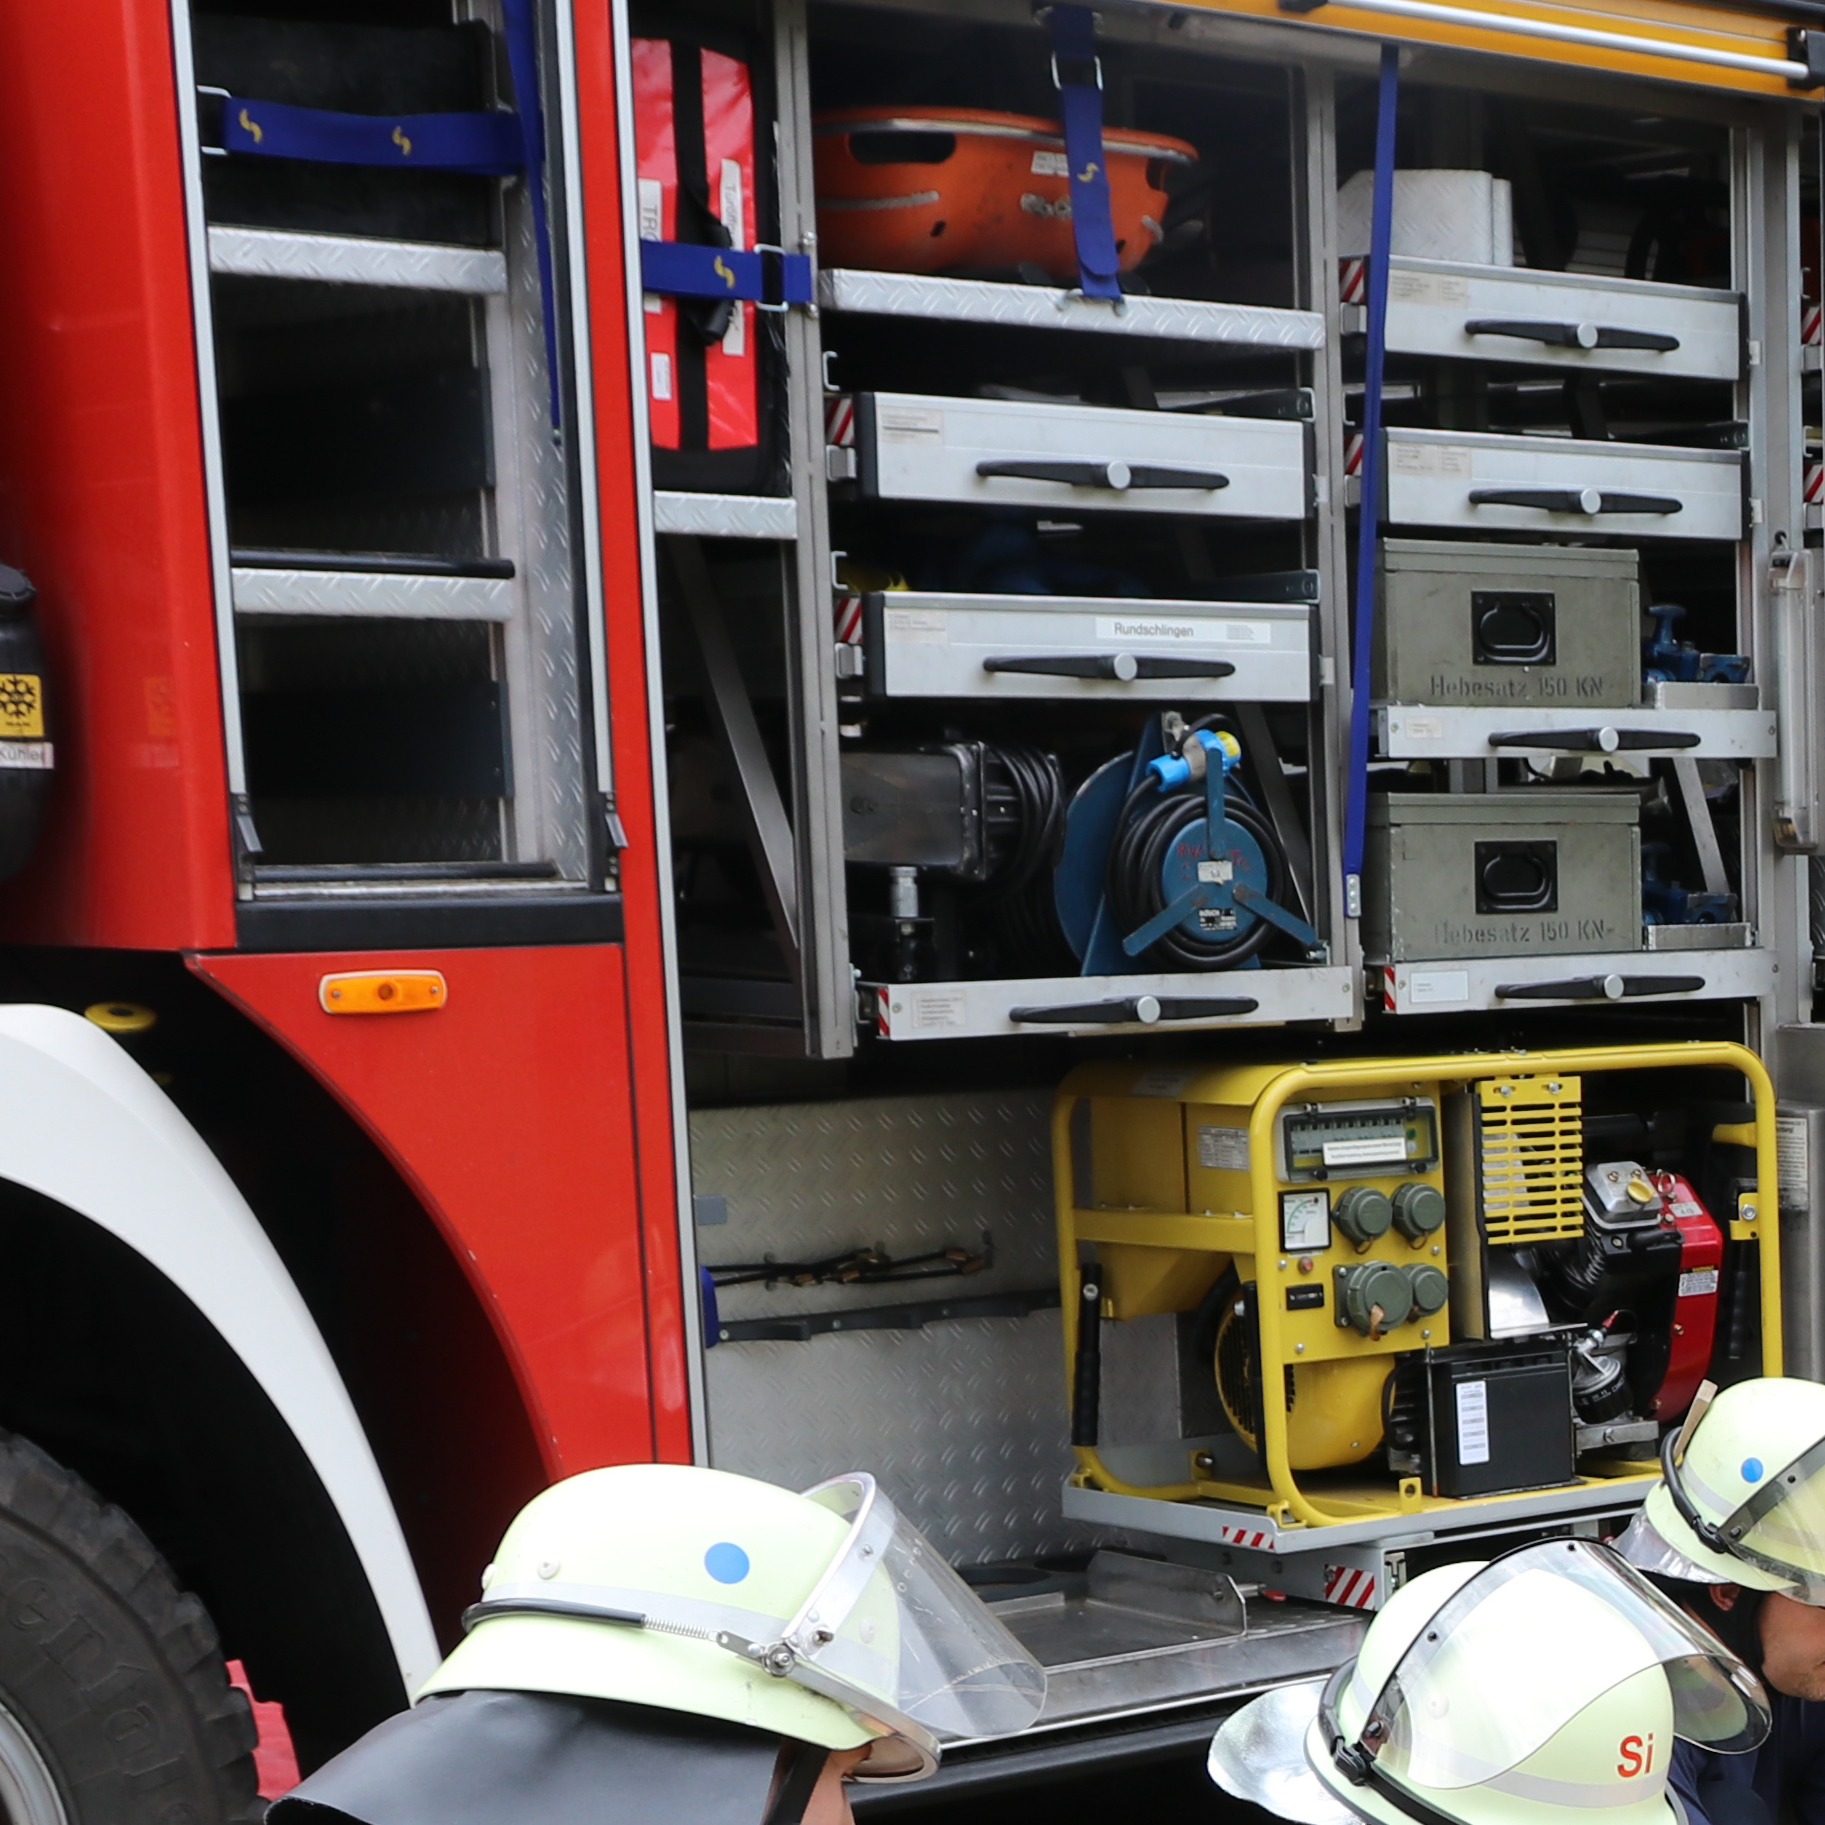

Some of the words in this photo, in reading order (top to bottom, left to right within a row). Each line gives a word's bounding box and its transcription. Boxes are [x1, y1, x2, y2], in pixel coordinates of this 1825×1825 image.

[1113, 622, 1194, 638] Rundschlingen
[1430, 675, 1528, 697] Hebesatz
[1538, 676, 1567, 696] 150
[1576, 676, 1603, 697] KN
[1433, 920, 1530, 944] Hebesatz
[1540, 921, 1569, 942] 150
[1617, 1732, 1654, 1778] Si
